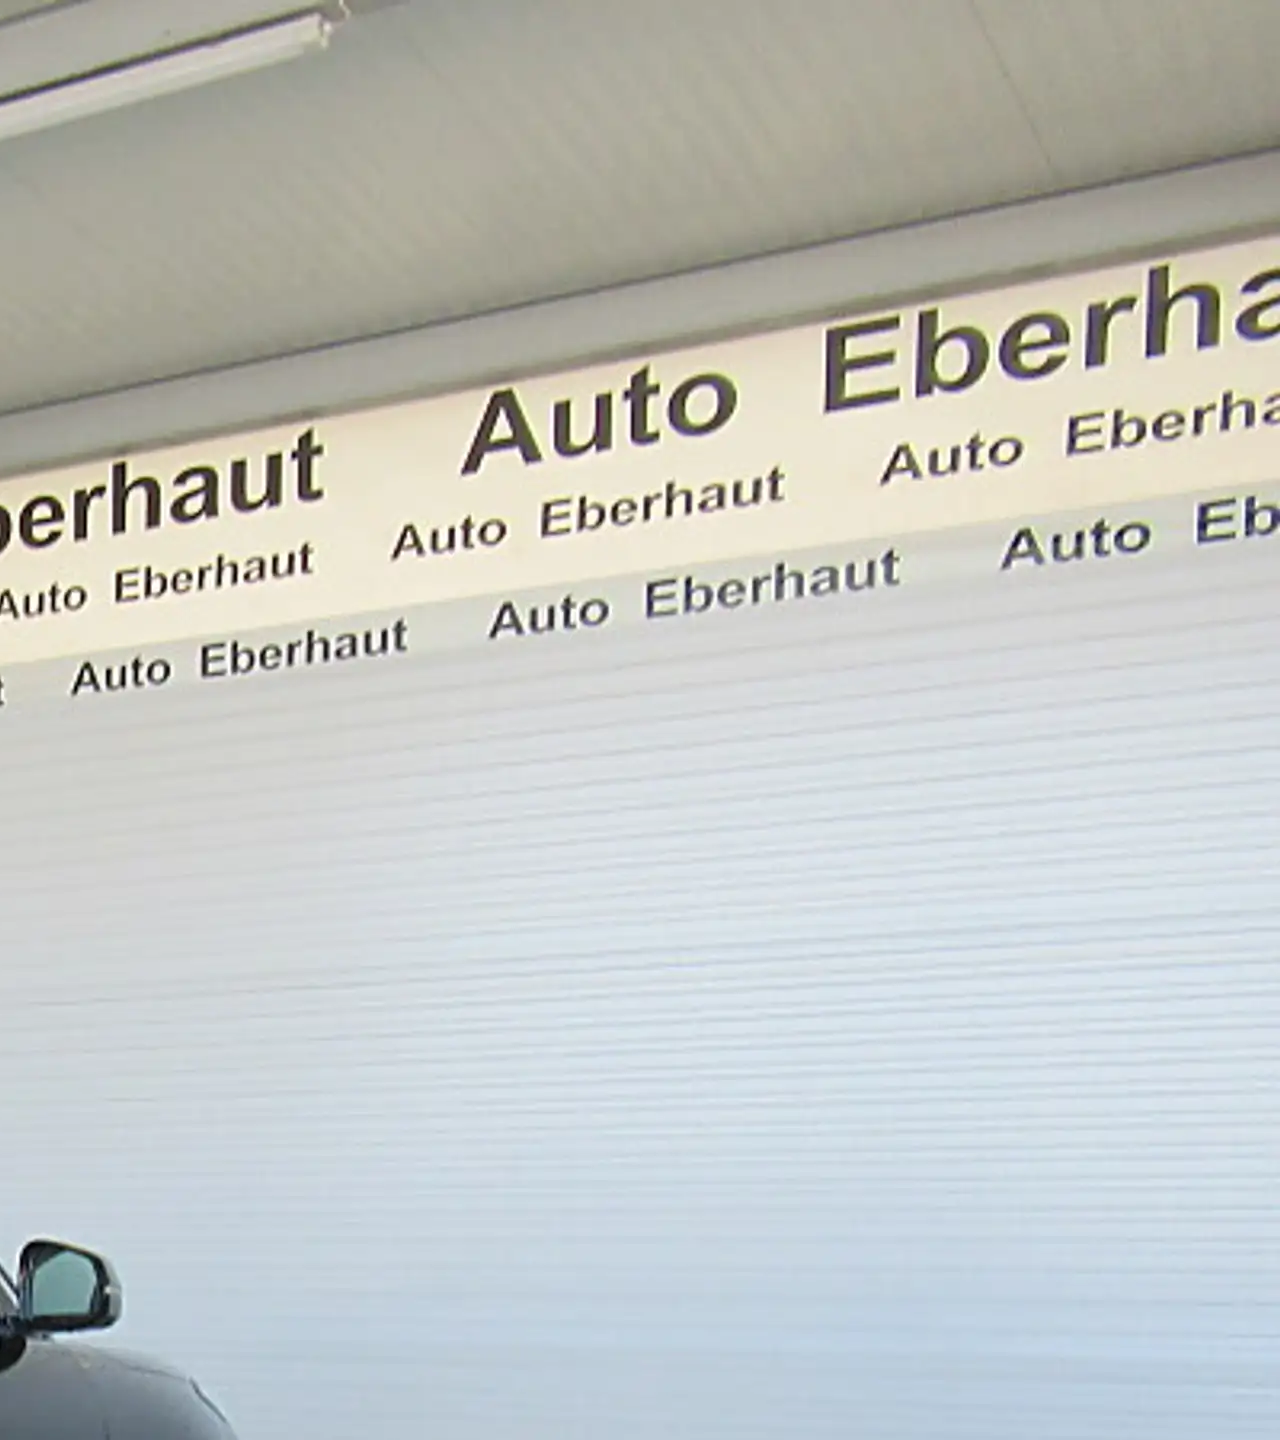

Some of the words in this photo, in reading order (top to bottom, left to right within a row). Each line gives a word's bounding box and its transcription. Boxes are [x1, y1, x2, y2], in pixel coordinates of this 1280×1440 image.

[459, 364, 739, 478] Auto
[879, 432, 1025, 487] Auto
[390, 514, 508, 562] Auto
[539, 465, 786, 539] Eberhaut
[1000, 517, 1153, 571] Auto
[113, 541, 314, 605] Eberhaut
[487, 593, 611, 640] Auto
[645, 547, 901, 620] Eberhaut
[70, 655, 172, 697] Auto
[199, 617, 408, 679] Eberhaut
